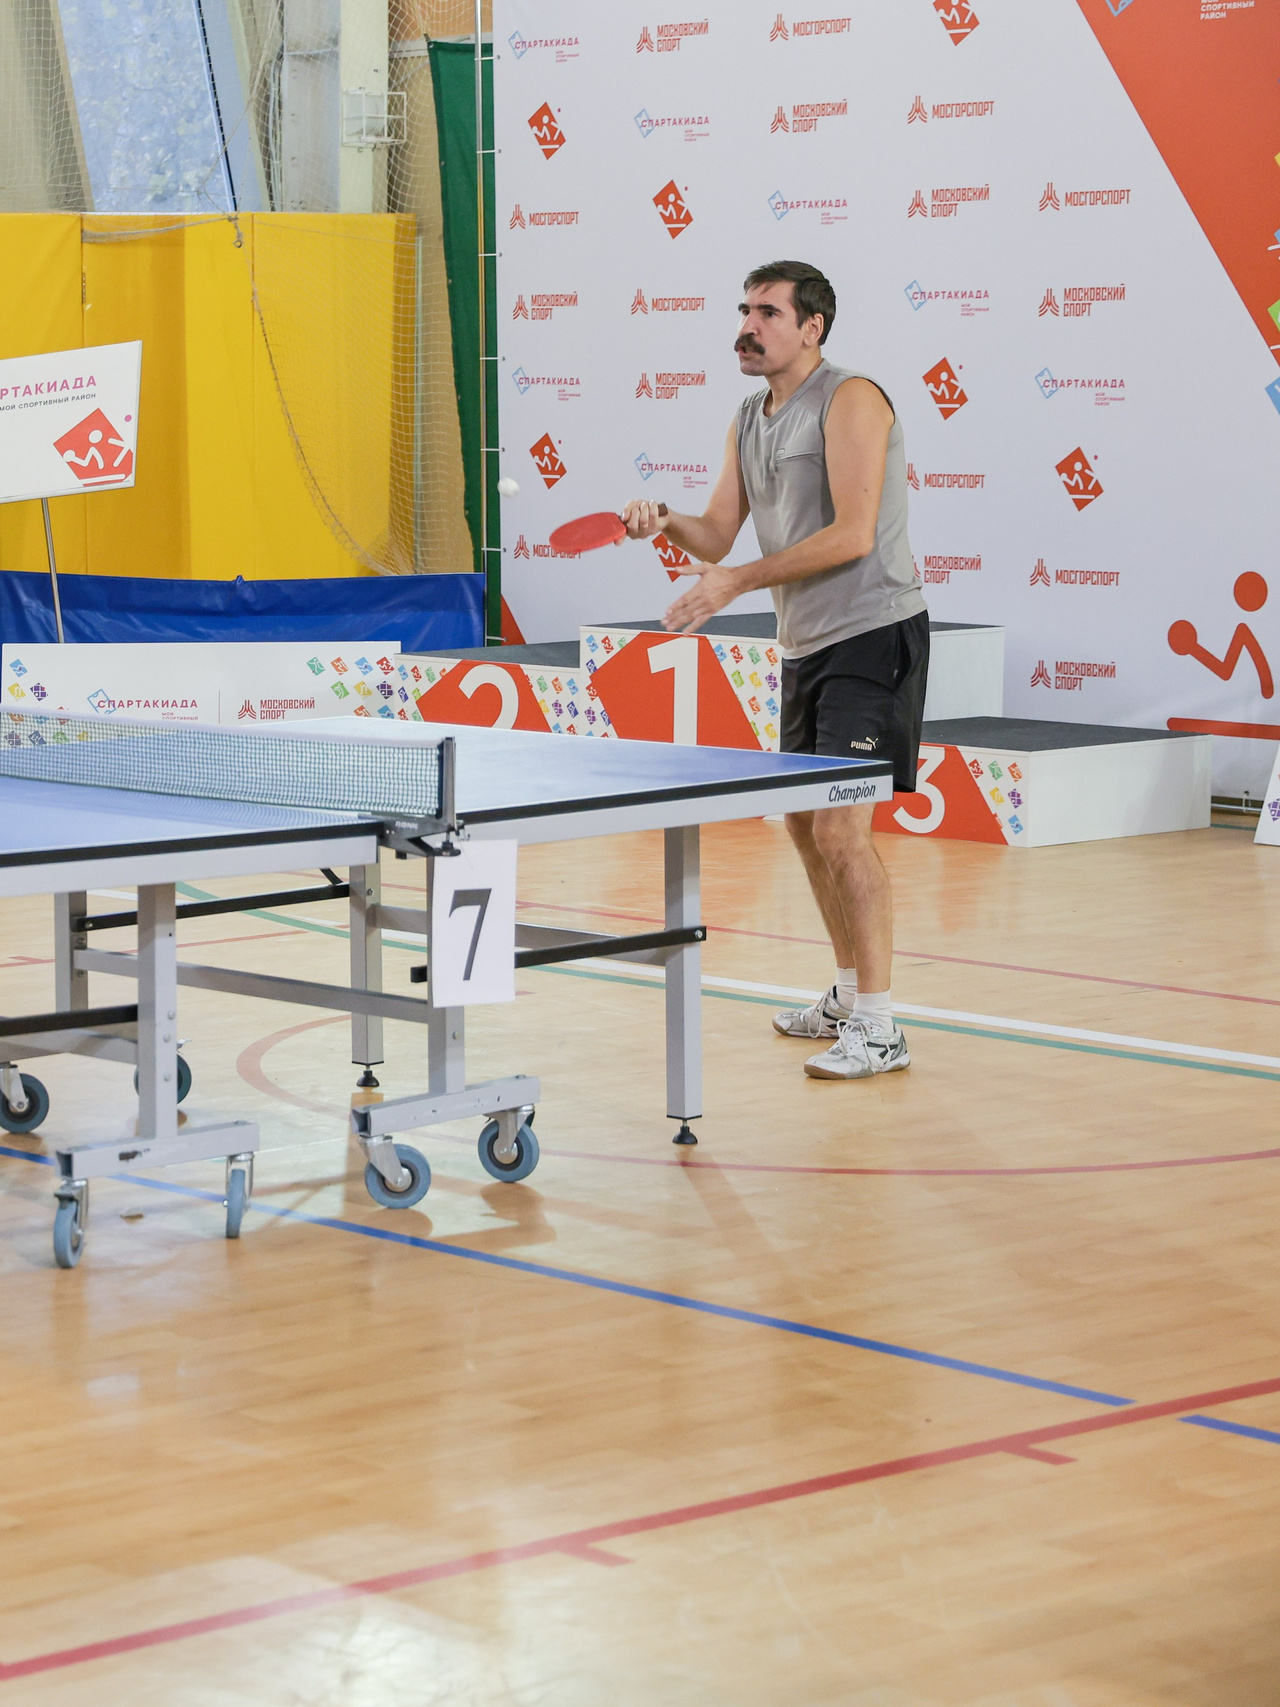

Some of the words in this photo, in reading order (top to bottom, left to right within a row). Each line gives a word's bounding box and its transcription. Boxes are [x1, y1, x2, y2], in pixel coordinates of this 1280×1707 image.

[656, 19, 709, 37] МОСКОВСКИЙ
[792, 18, 852, 37] МОСГОРСПОРТ
[514, 37, 580, 49] СПАРТАКИАДА
[656, 37, 682, 52] СПОРТ
[792, 99, 848, 118] МОСКОВСКИЙ
[932, 101, 995, 119] МОСГОРСПОРТ
[641, 116, 710, 128] СПАРТАКИАДА
[792, 118, 819, 133] СПОРТ
[931, 184, 990, 202] МОСКОВСКИЙ
[1064, 189, 1131, 207] МОСГОРСПОРТ
[775, 199, 848, 210] СПАРТАКИАДА
[931, 203, 959, 218] СПОРТ
[529, 211, 580, 226] МОСГОРСПОРТ
[531, 291, 579, 306] МОСКОВСКИЙ
[912, 290, 990, 300] СПАРТАКИАДА
[1063, 283, 1126, 301] МОСКОВСКИЙ
[651, 297, 706, 312] МОСГОРСПОРТ
[1063, 303, 1092, 317] СПОРТ
[531, 307, 554, 320] СПОРТ
[518, 377, 581, 386] СПАРТАКИАДА
[655, 370, 706, 386] МОСКОВСКИЙ
[1043, 379, 1125, 388] СПАРТАКИАДА
[655, 386, 680, 399] СПОРТ
[0, 404, 16, 412] МОЙ
[18, 397, 69, 409] СПОРТИВНЫЙ
[71, 393, 96, 402] РАЙОН
[641, 463, 708, 473] СПАРТАКИАДА
[924, 473, 986, 489] МОСГОРСПОРТ
[924, 554, 982, 571] МОСКОВСКИЙ
[924, 570, 951, 585] СПОРТ
[1055, 569, 1120, 586] МОСГОРСПОРТ
[1055, 661, 1117, 679] МОСКОВСКИЙ
[647, 635, 699, 746] 1
[1054, 676, 1084, 691] СПОРТ
[97, 699, 198, 709] СПАРТАКИАДА
[259, 696, 316, 710] МОСКОВСКИЙ
[259, 709, 286, 720] СПОРТ
[850, 740, 873, 752] PUMA
[828, 780, 876, 803] Champion
[893, 746, 945, 834] 3
[449, 888, 492, 981] 7
